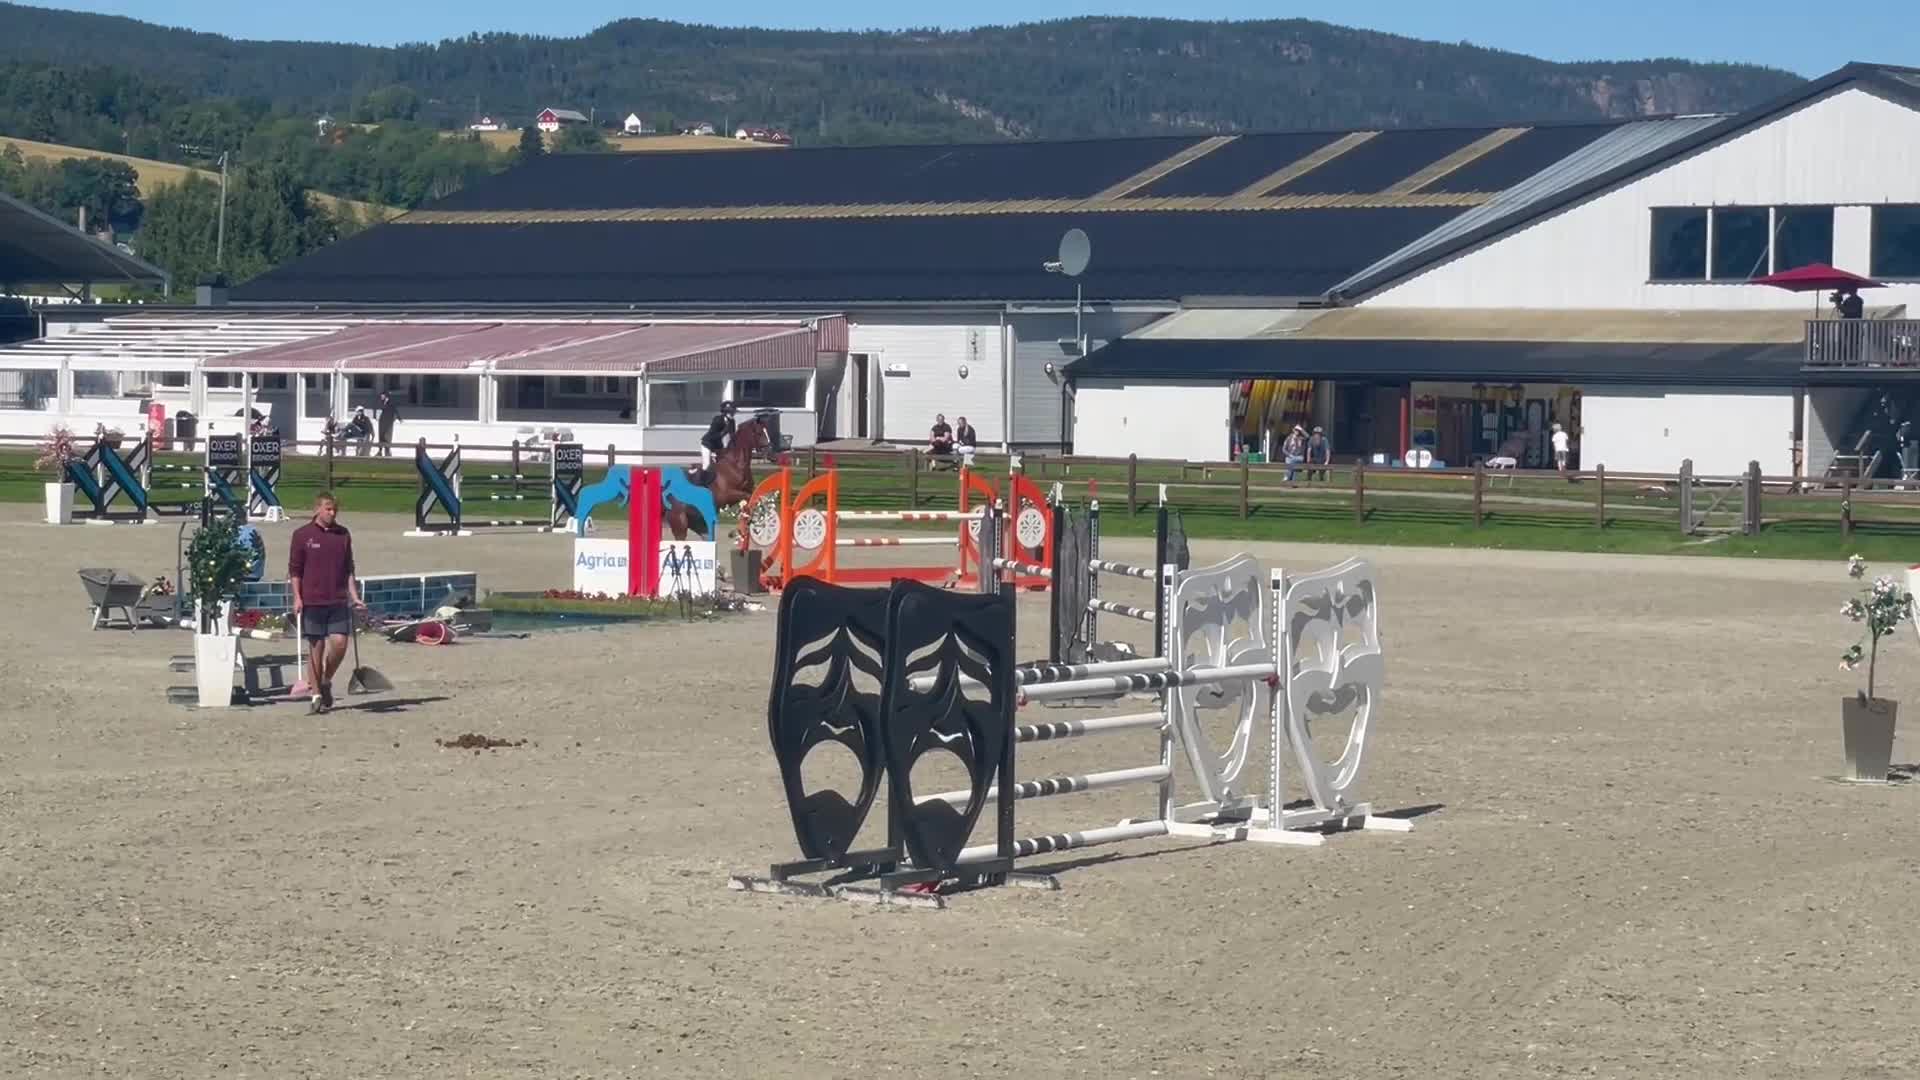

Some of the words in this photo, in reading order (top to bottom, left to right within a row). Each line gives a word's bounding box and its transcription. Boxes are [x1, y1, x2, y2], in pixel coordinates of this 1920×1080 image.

[210, 440, 237, 452] OXER
[252, 441, 279, 453] OXER
[556, 448, 582, 461] OXER
[576, 551, 617, 570] Agria
